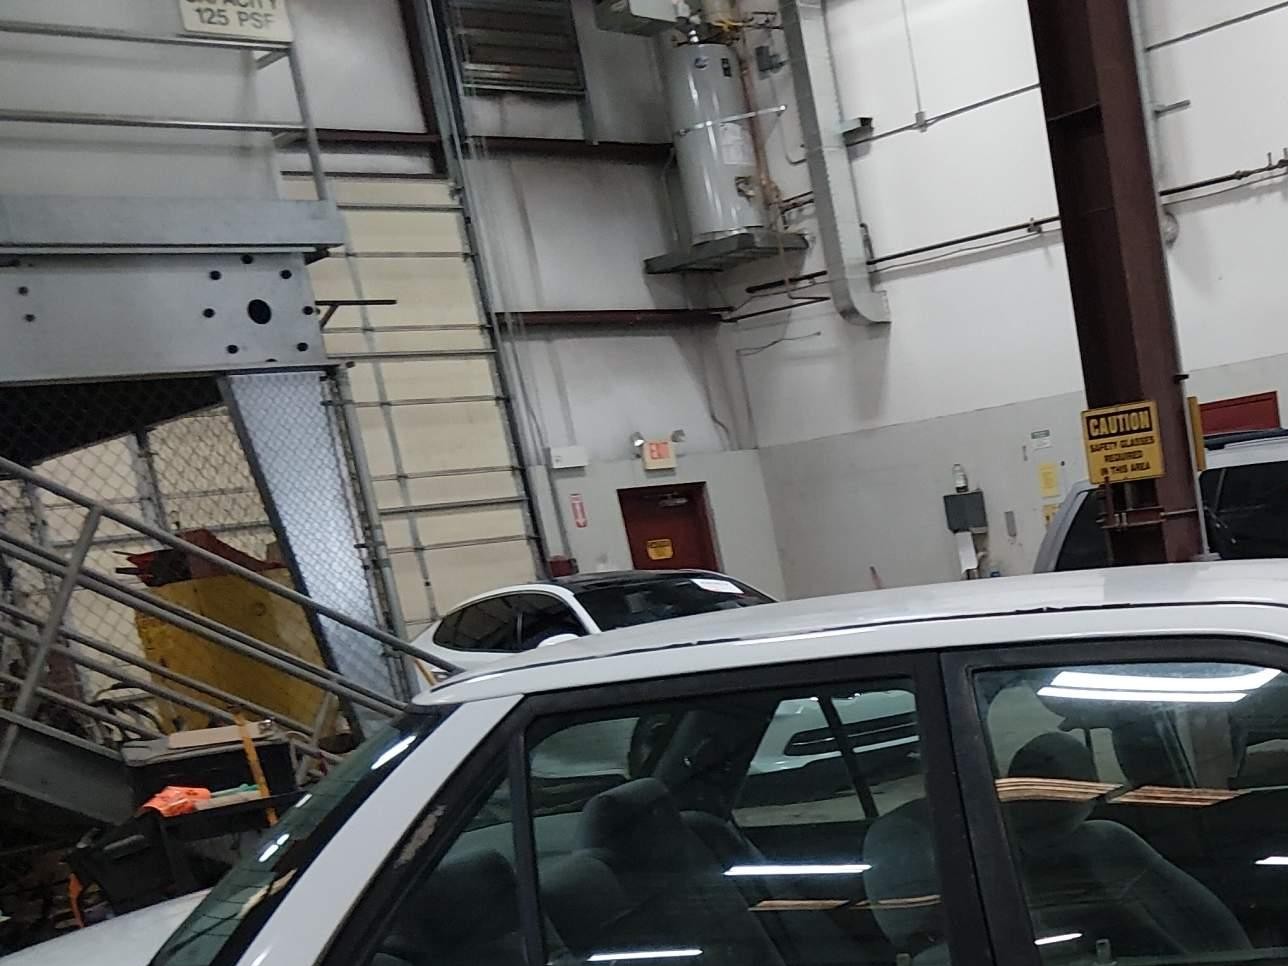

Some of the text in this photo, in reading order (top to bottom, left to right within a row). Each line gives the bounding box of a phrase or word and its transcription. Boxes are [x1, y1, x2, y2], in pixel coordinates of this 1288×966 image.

[195, 8, 275, 29] 125 PSF
[1089, 410, 1151, 437] CAUTION
[1090, 436, 1155, 453] SAFETY GLASSES
[1104, 450, 1143, 463] REQUIRED
[1100, 461, 1151, 477] IN THIS AREA
